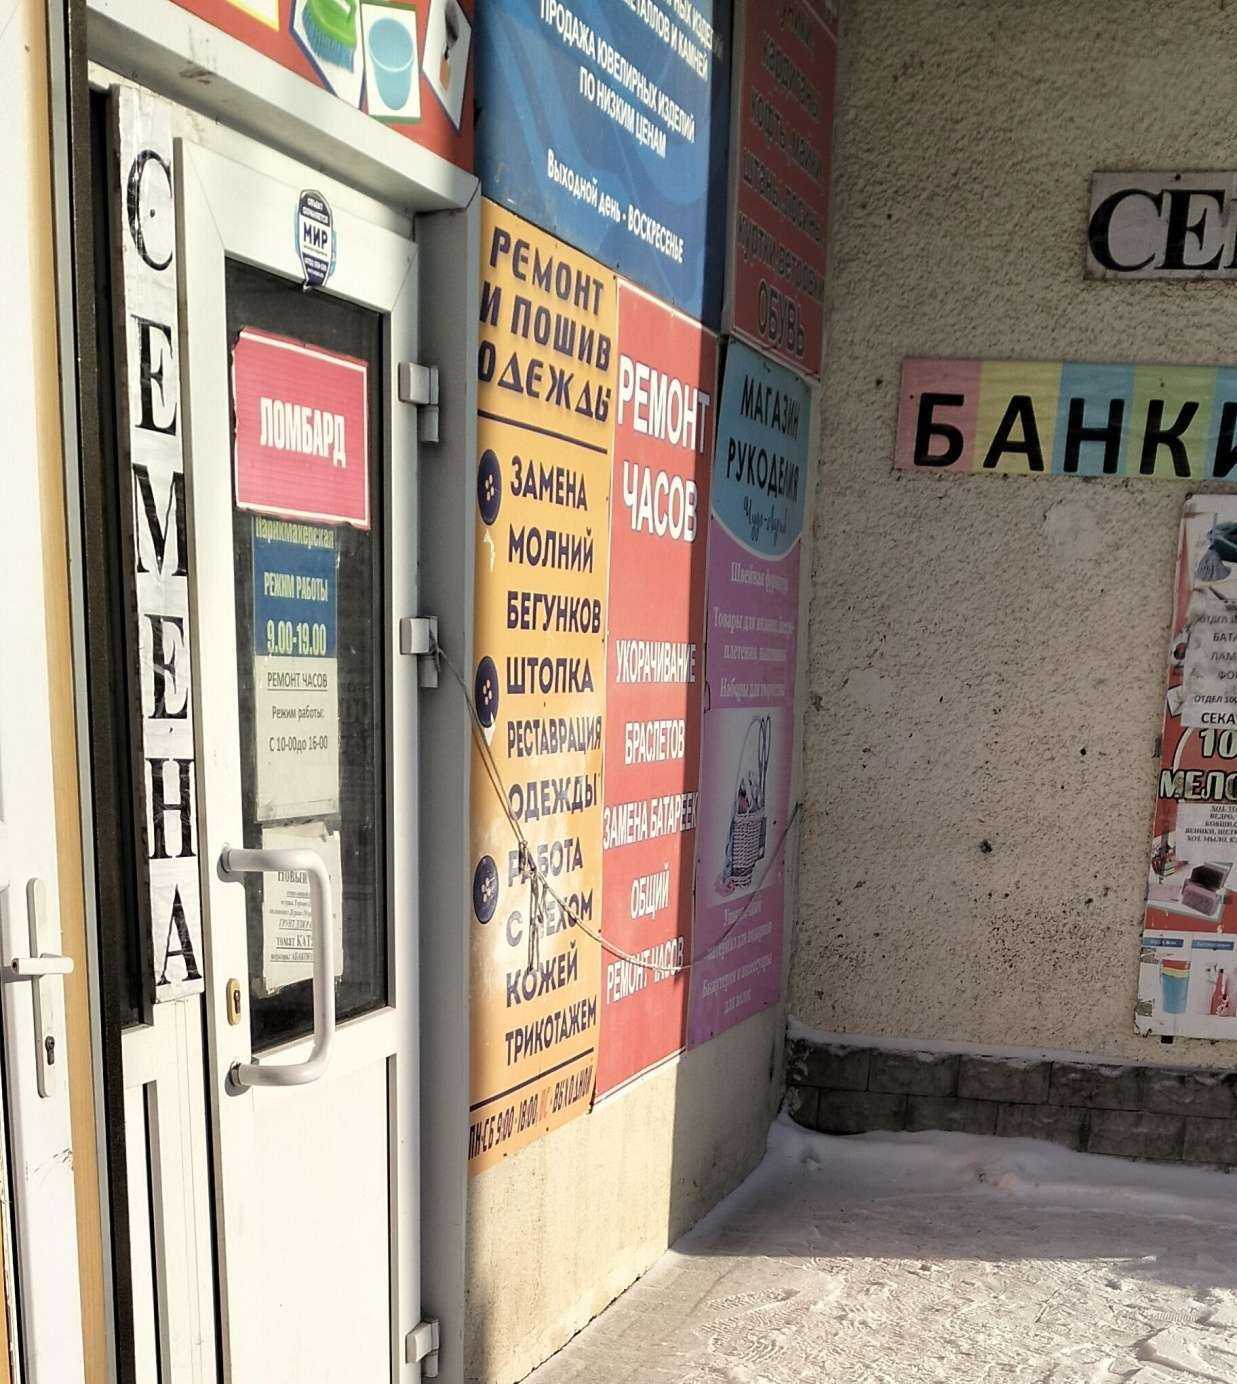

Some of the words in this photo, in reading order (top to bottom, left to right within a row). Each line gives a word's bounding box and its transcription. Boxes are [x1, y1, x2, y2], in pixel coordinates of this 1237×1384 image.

[624, 0, 670, 43] ЕТАЛЛОВ
[670, 23, 678, 51] И
[678, 29, 708, 82] КАМНЕЙ
[540, 0, 596, 61] ПРОДАЖА
[598, 37, 658, 112] ЮВЕЛИРНЫХ
[658, 90, 695, 144] ИЗДЕЛИЙ
[579, 65, 596, 102] ПО
[596, 80, 636, 134] НИЗКИМ
[635, 111, 667, 159] ЦЕНАМ
[303, 221, 328, 249] МИР
[628, 203, 685, 264] ВОСКРЕСЕНЬЕ
[1088, 188, 1237, 273] СЕ
[489, 226, 604, 316] РЕМОНТ
[479, 281, 502, 327] И
[510, 294, 612, 372] ПОШИВ
[757, 278, 808, 358] ОБУВЬ
[477, 339, 612, 423] ОДЕЖДЫ
[617, 354, 711, 454] РЕМОНТ
[740, 373, 800, 442] МАГАЗИН
[260, 397, 347, 468] ЛОМБАРД
[510, 455, 588, 511] ЗАМЕНА
[726, 437, 800, 503] РУКОДЕЛИЯ
[622, 460, 699, 543] ЧАСОВ
[126, 149, 205, 986] СЕМЕНА
[508, 522, 594, 574] МОЛНИЙ
[264, 571, 295, 599] РЕЖИМ
[296, 576, 328, 601] РАБОТЫ
[507, 590, 601, 634] БЕГУНКОВ
[266, 619, 327, 656] 9.00-19.00
[616, 640, 697, 683] УКОРАЧИВАНИЕ
[267, 671, 301, 688] РЕМОНТ
[302, 673, 328, 689] ЧАСОВ
[506, 656, 594, 695] ШТОПКА
[272, 705, 297, 720] Режим
[507, 715, 602, 759] РЕСТАВРАЦИЯ
[625, 719, 686, 766] БРАСЛЕТОВ
[1201, 712, 1237, 725] СЕКА
[508, 772, 597, 823] ОДЕЖДЫ
[603, 800, 648, 850] ЗАМЕНА
[650, 791, 698, 838] БАТАРЕЕК
[506, 910, 523, 947] С
[533, 888, 593, 940] ЕХОМ
[630, 862, 670, 920] ОБЩИЙ
[506, 940, 578, 1008] КОЖЕЙ
[606, 949, 651, 1006] РЕМОНТ
[651, 936, 684, 984] ЧАСОВ
[505, 994, 597, 1067] ТРИКОТАЖЕМ
